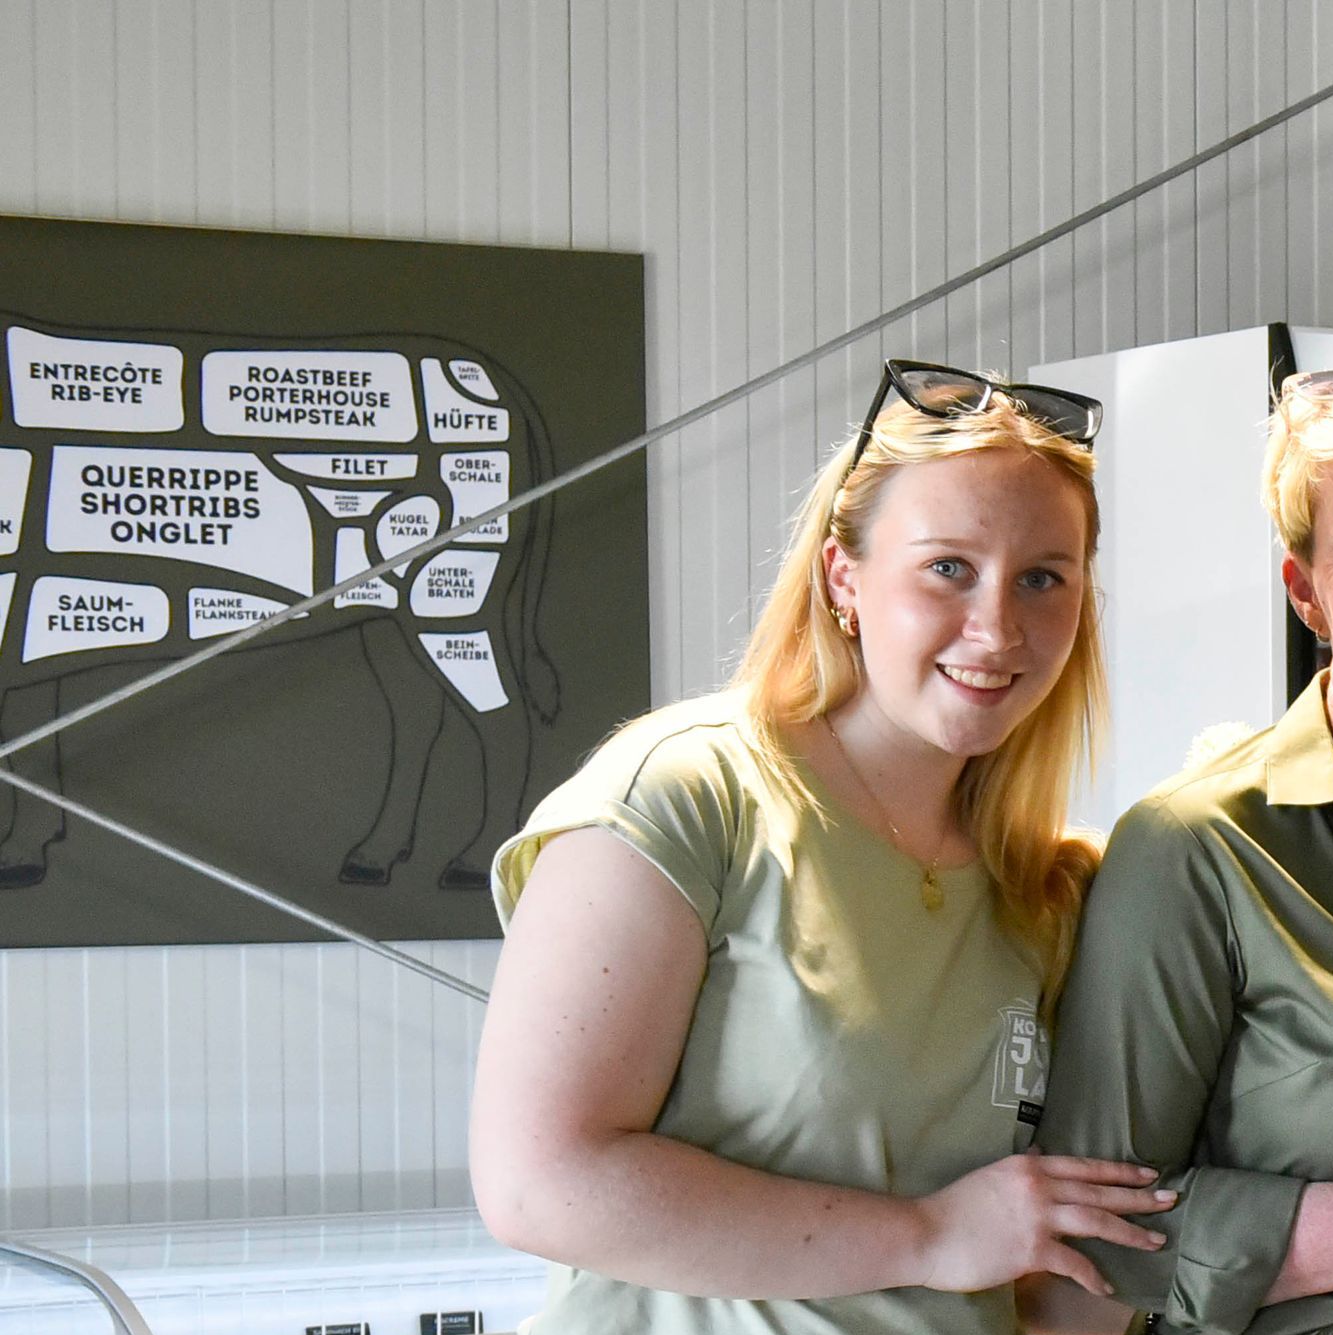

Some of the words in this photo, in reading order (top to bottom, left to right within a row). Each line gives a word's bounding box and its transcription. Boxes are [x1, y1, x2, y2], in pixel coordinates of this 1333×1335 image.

[30, 361, 163, 385] ENTRECÔTE
[247, 366, 372, 387] ROASTBEEF
[51, 384, 143, 404] RIB-EYE
[229, 385, 391, 408] PORTERHOUSE
[244, 406, 376, 427] RUMPSTEAK
[433, 408, 498, 431] HÜFTE
[331, 458, 388, 475] FILET
[454, 458, 497, 470] OBER-
[80, 464, 259, 492] QUERRIPPE
[449, 471, 502, 483] SCHALE
[80, 492, 261, 519] SHORTRIBS
[389, 514, 429, 525] KUGEL
[110, 520, 233, 546] ONGLET
[390, 526, 428, 537] TATAR
[428, 567, 473, 577] UNTER-
[427, 578, 475, 588] SCHALE
[427, 588, 475, 598] BRATEN
[58, 595, 133, 613] SAUM-
[193, 598, 243, 608] FLANKE
[48, 614, 144, 634] FLEISCH
[445, 640, 480, 650] BEIN-
[436, 650, 489, 661] SCHEIBE
